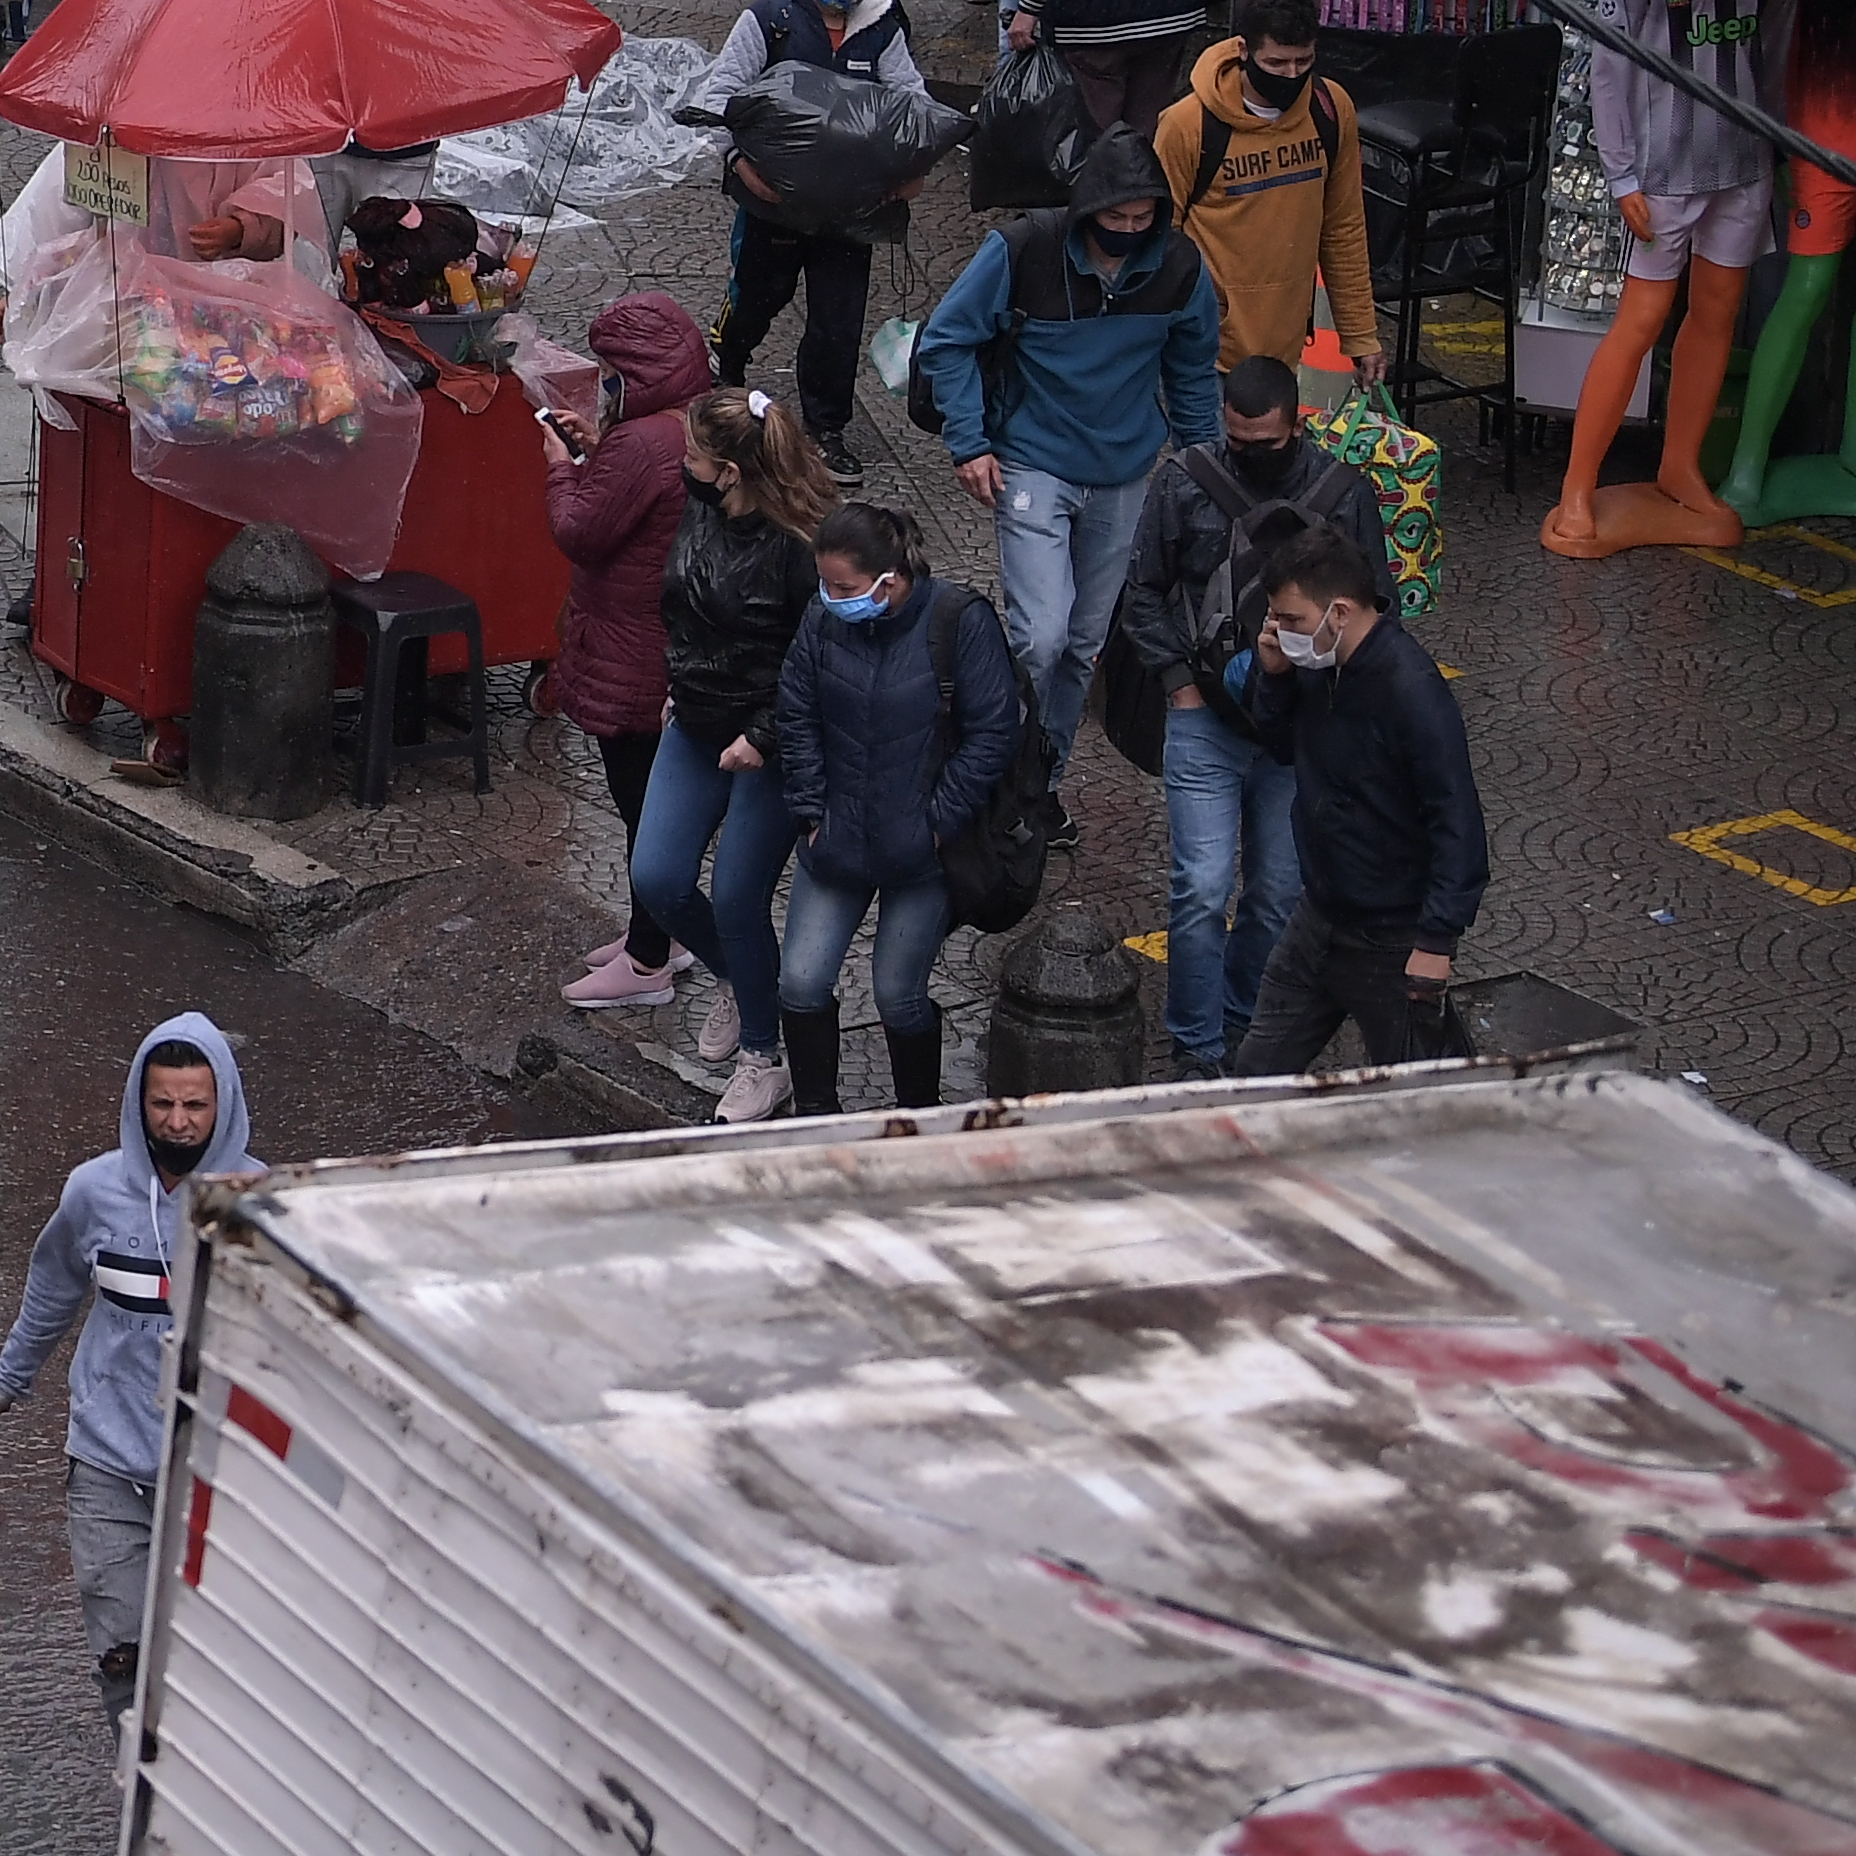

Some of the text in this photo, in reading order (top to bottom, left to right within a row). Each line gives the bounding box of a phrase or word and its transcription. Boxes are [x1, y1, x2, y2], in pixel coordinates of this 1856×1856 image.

[1687, 15, 1757, 45] Jeep
[1224, 137, 1327, 182] SURF CAMP
